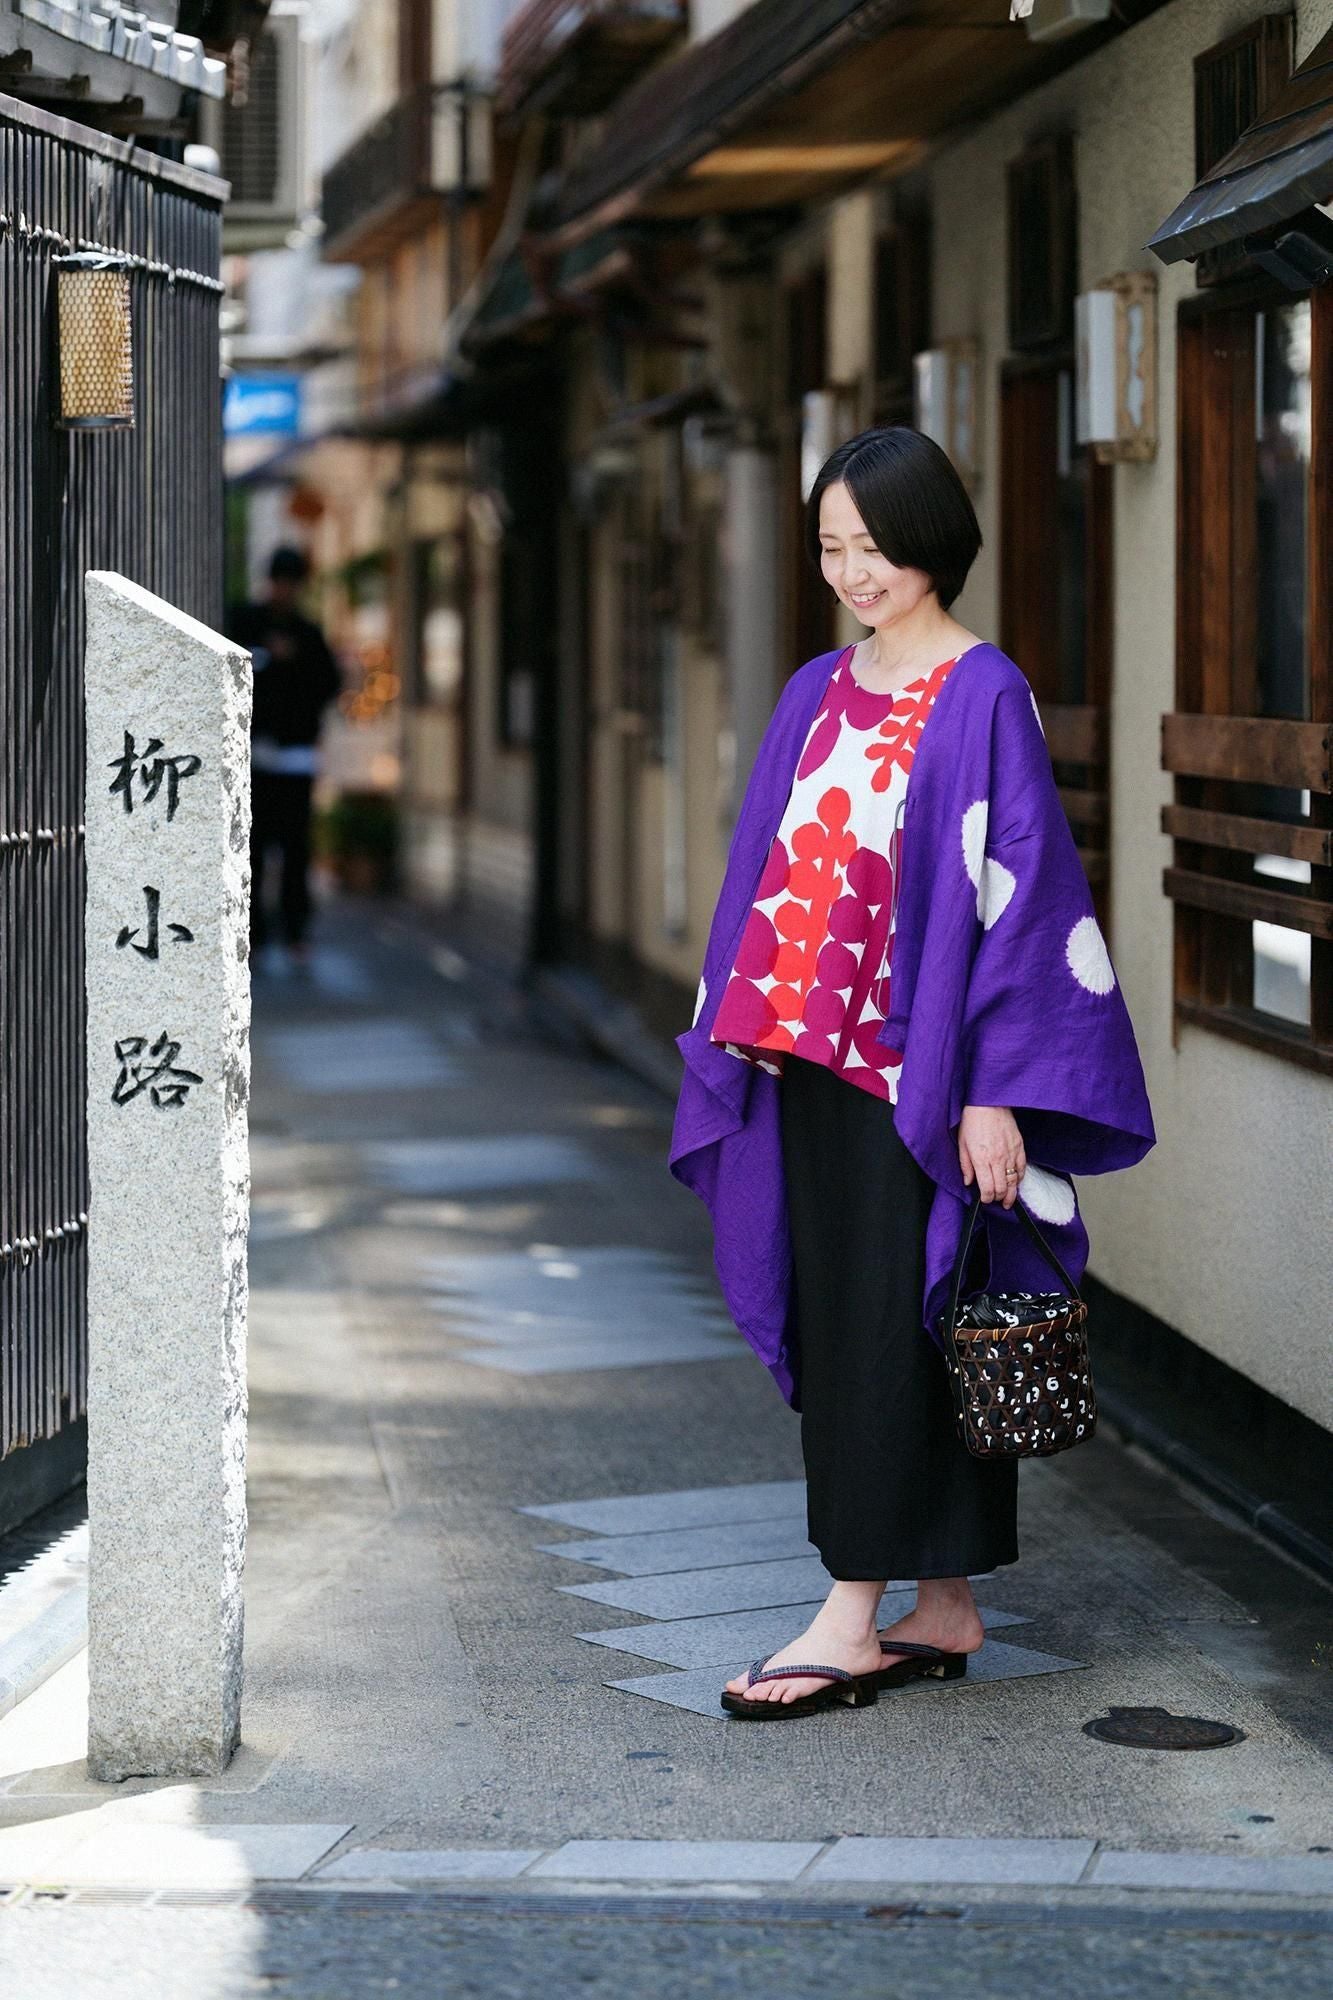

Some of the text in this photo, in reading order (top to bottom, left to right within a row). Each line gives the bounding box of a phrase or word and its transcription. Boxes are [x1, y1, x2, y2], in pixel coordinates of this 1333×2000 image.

[107, 729, 204, 1108] 柳小路
[1046, 1376, 1060, 1391] 6
